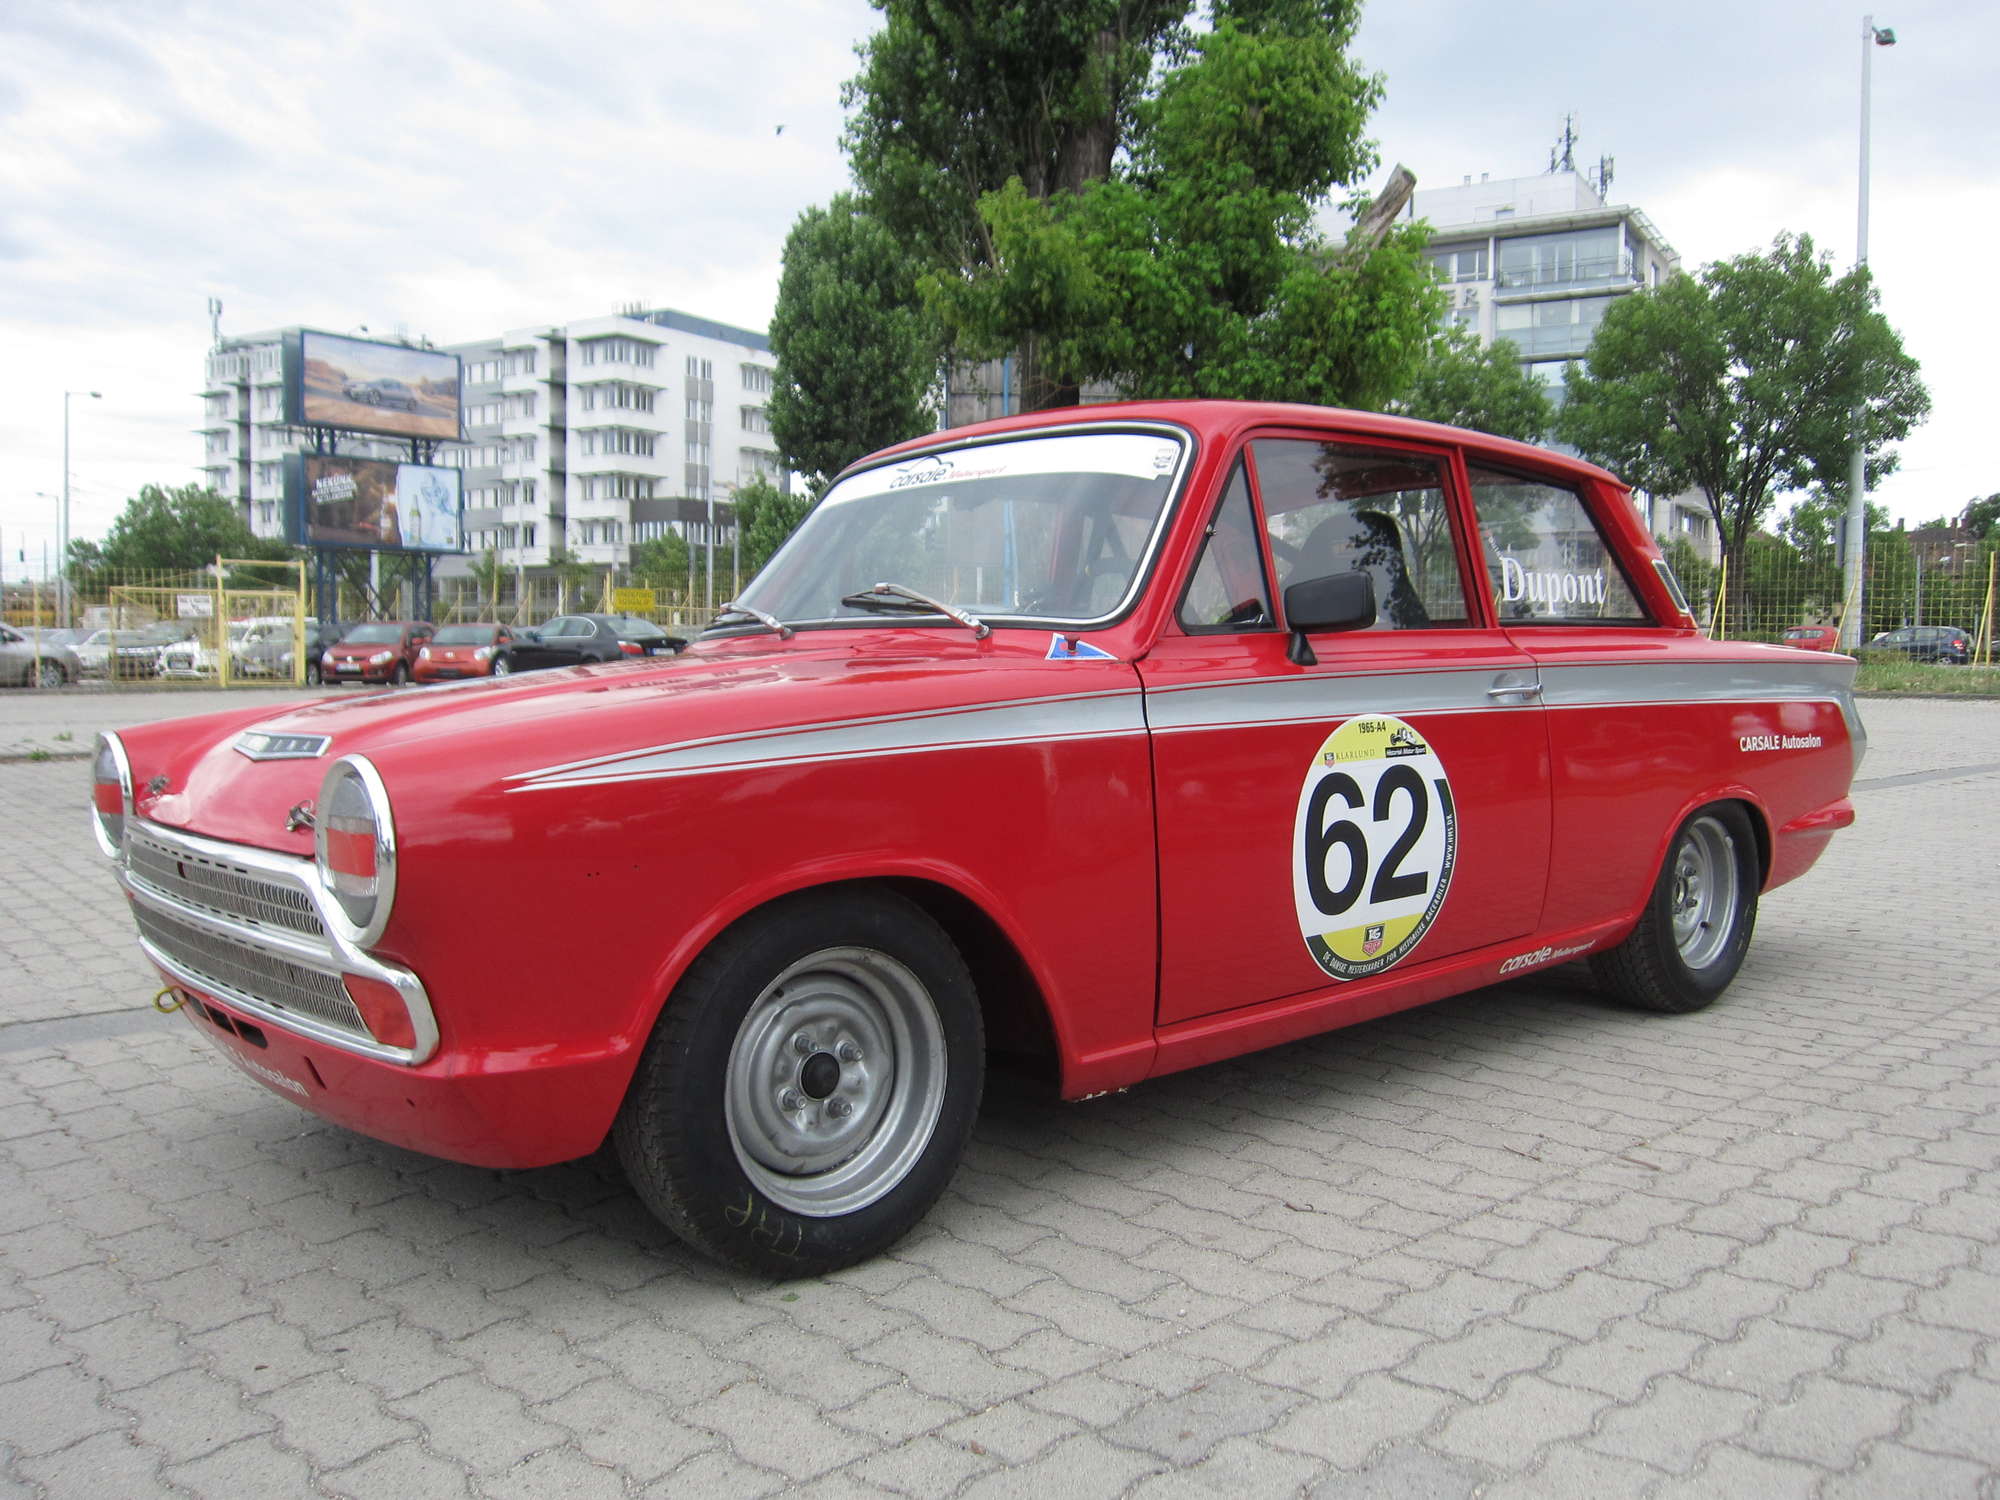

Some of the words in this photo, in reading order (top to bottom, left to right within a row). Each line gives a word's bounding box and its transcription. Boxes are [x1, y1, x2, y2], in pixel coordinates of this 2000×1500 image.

[1500, 556, 1604, 615] Dupont
[1739, 735, 1780, 752] CARSALE
[1781, 733, 1822, 750] Autosalon
[1304, 764, 1429, 916] 62
